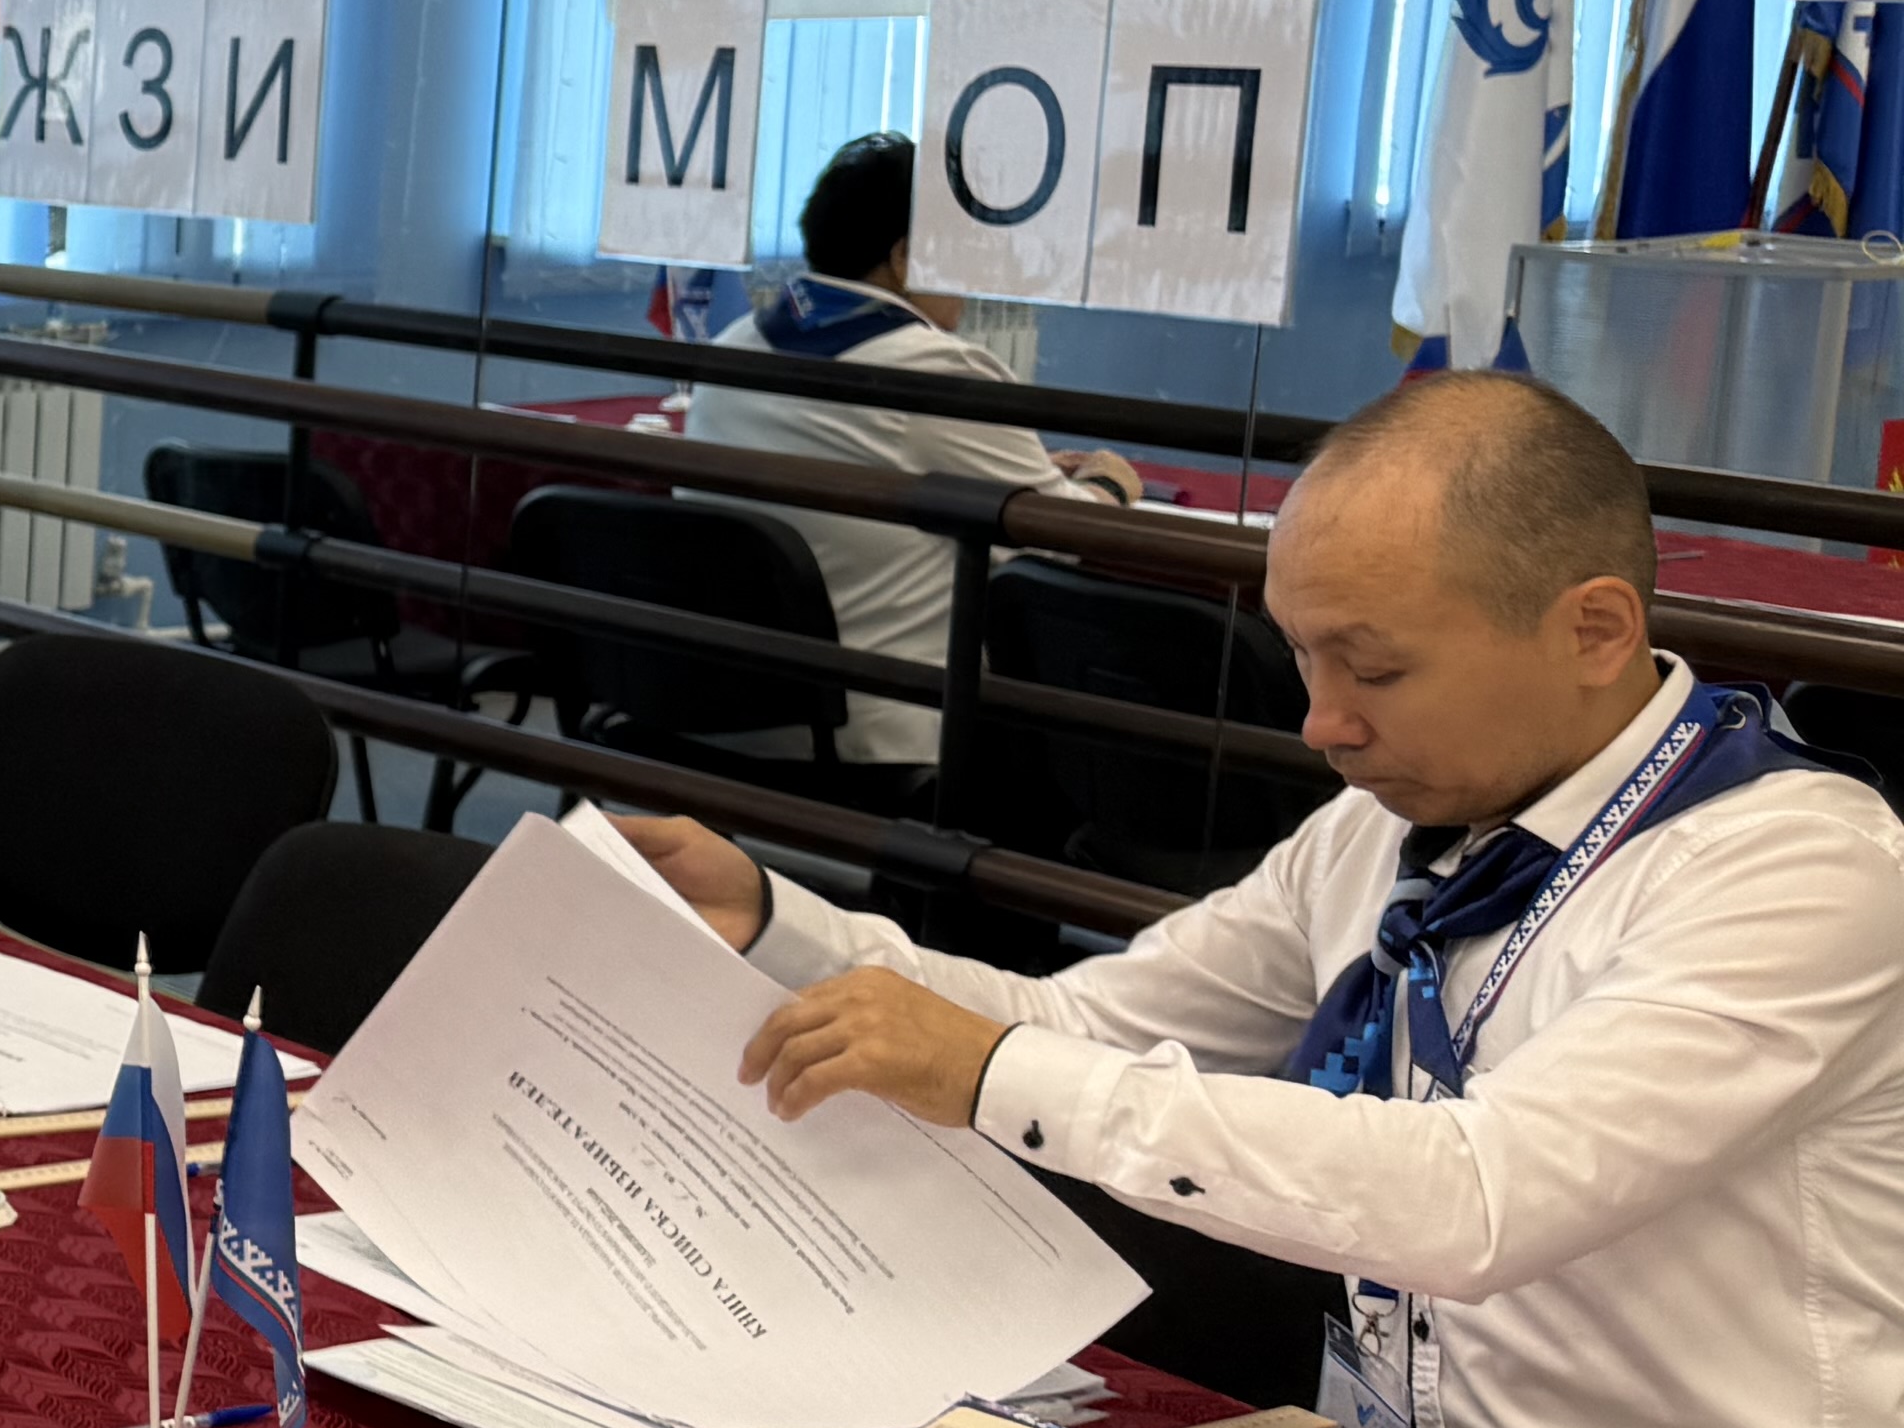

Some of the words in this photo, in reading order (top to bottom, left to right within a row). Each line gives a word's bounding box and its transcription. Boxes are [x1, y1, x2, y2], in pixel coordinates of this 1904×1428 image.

[118, 27, 176, 153] З
[223, 36, 295, 166] И
[624, 44, 737, 192] М
[944, 66, 1067, 228] О
[1136, 63, 1263, 235] П
[642, 1196, 713, 1278] СПИСКА
[711, 1275, 769, 1340] КНИГА
